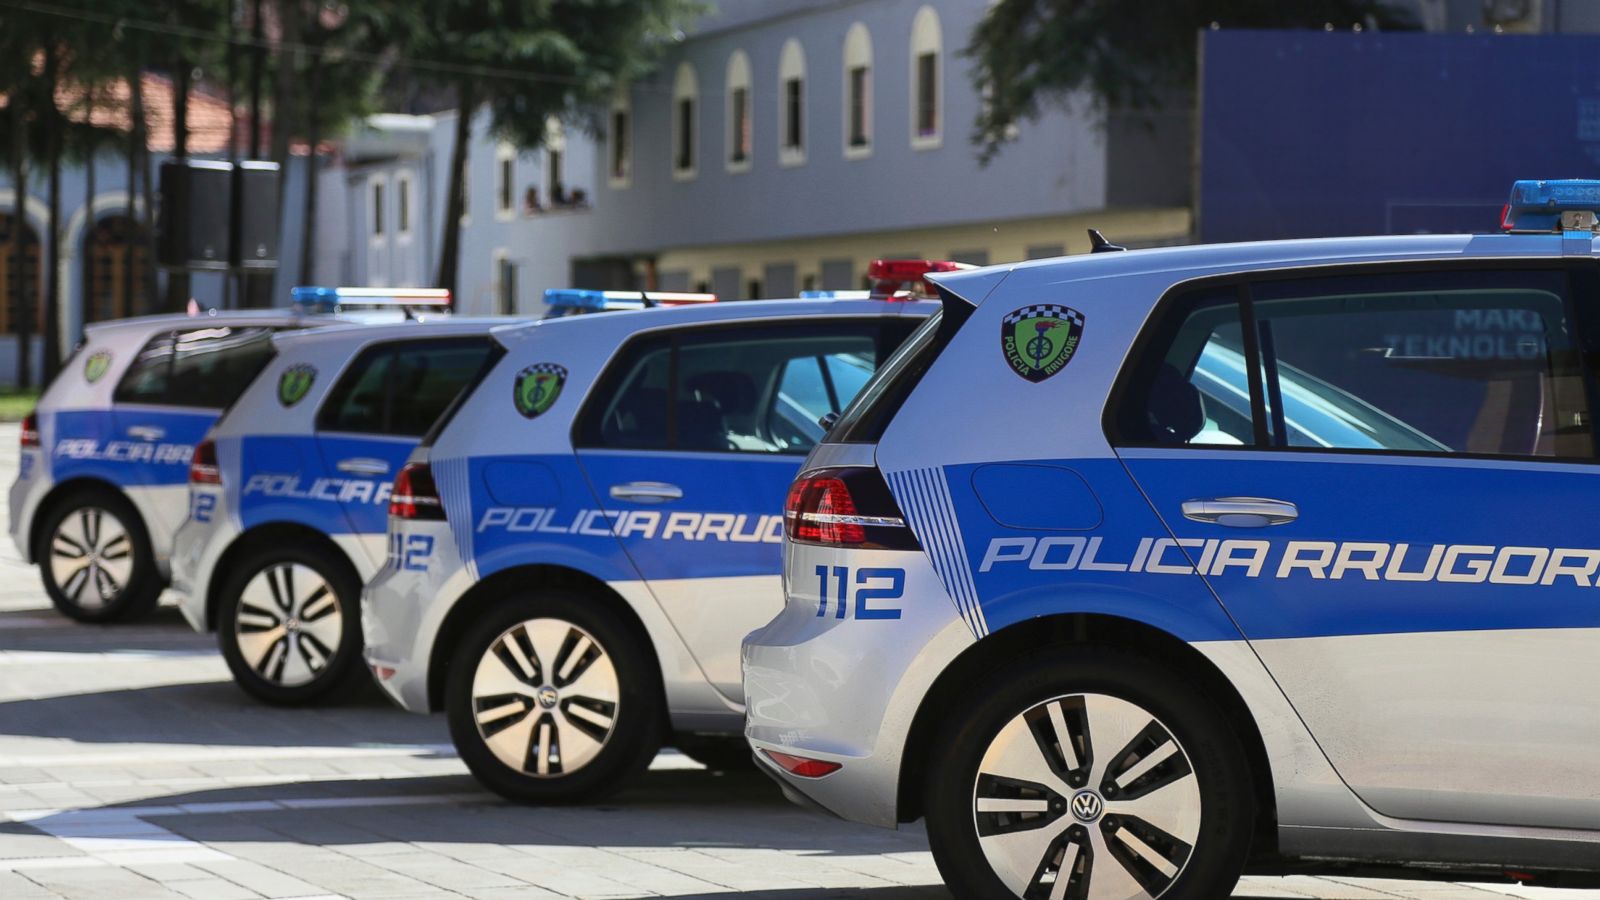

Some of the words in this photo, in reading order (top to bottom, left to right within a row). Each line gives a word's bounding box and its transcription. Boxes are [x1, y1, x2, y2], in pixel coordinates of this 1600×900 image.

[1004, 335, 1031, 376] POLICIA
[1044, 335, 1079, 376] RRUGORE
[1384, 335, 1547, 360] TEKNOLO
[242, 474, 375, 503] POLICIA
[476, 507, 660, 538] POLICIA
[978, 536, 1272, 578] POLICIA
[1275, 541, 1600, 587] RRUGOR
[815, 565, 906, 620] 112
